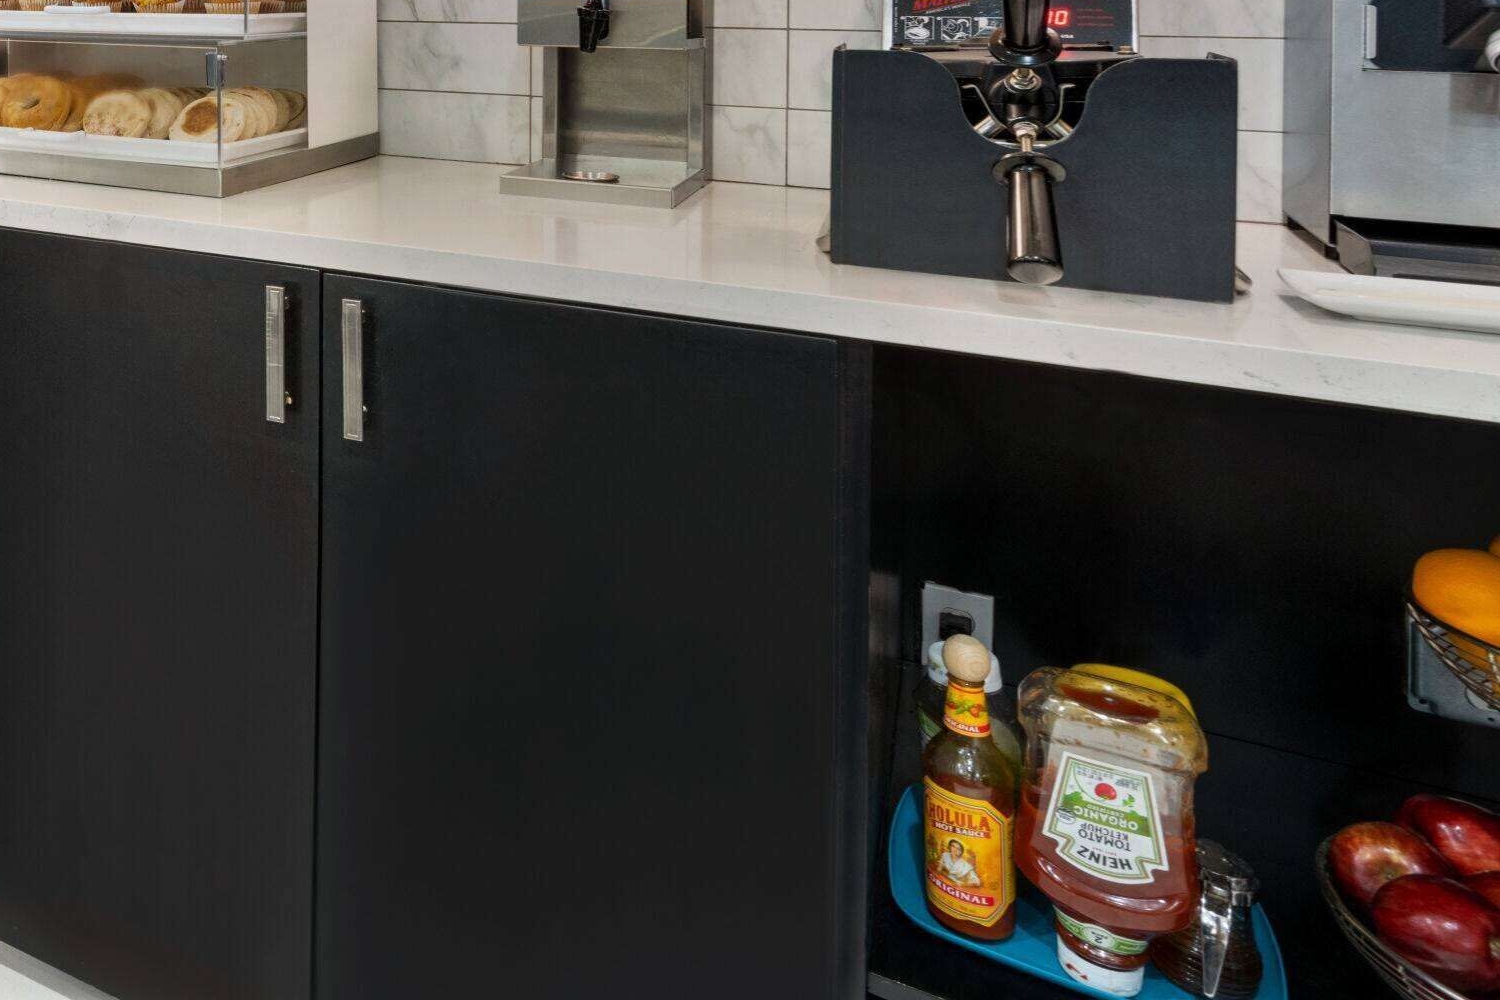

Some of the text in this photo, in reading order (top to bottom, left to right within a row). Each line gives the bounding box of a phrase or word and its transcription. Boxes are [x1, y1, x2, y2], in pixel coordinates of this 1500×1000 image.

[928, 802, 991, 831] HOLULA
[1074, 805, 1138, 831] ORGANIC
[935, 821, 985, 838] HOT SAUCE
[1077, 828, 1132, 852] TOMATO
[1080, 822, 1129, 841] KETCHUP
[1076, 845, 1133, 871] HEINZ
